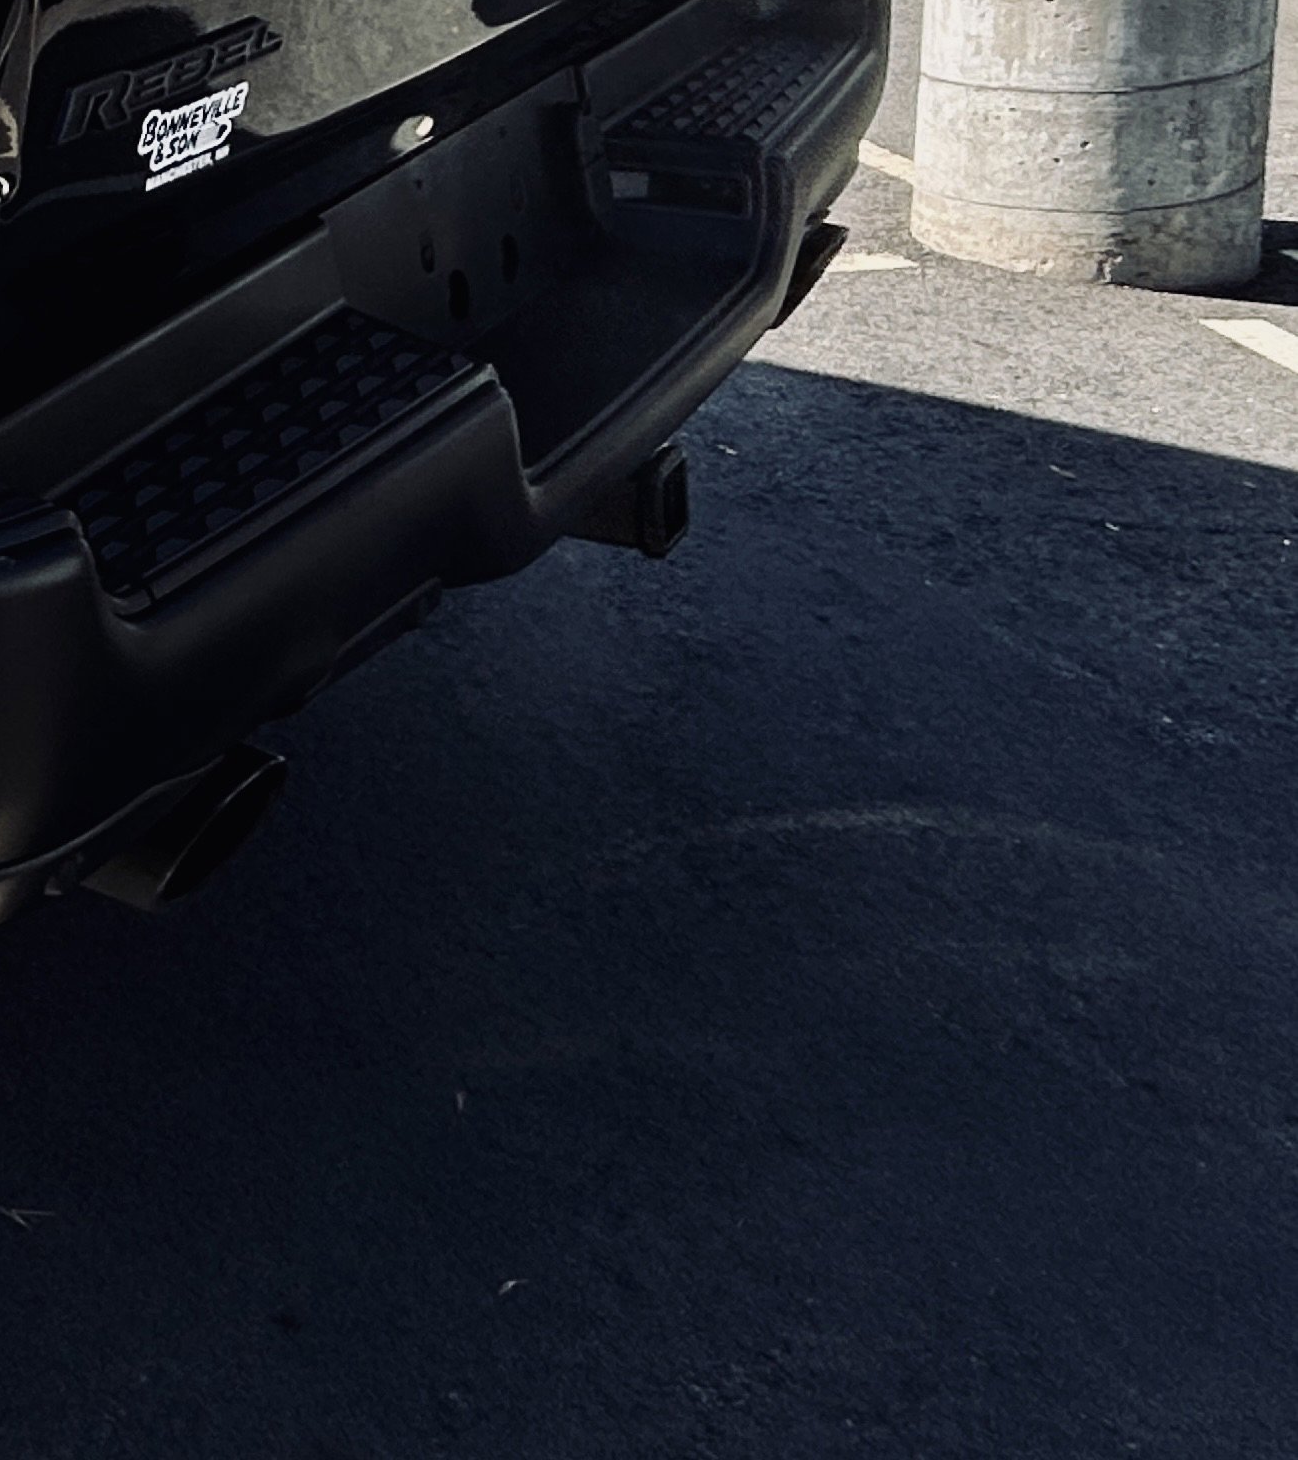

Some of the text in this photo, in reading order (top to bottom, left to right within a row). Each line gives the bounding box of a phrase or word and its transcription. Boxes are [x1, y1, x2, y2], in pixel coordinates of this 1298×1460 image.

[57, 16, 283, 146] REBEL
[140, 85, 247, 150] BONNEVILLE
[165, 128, 202, 159] SON
